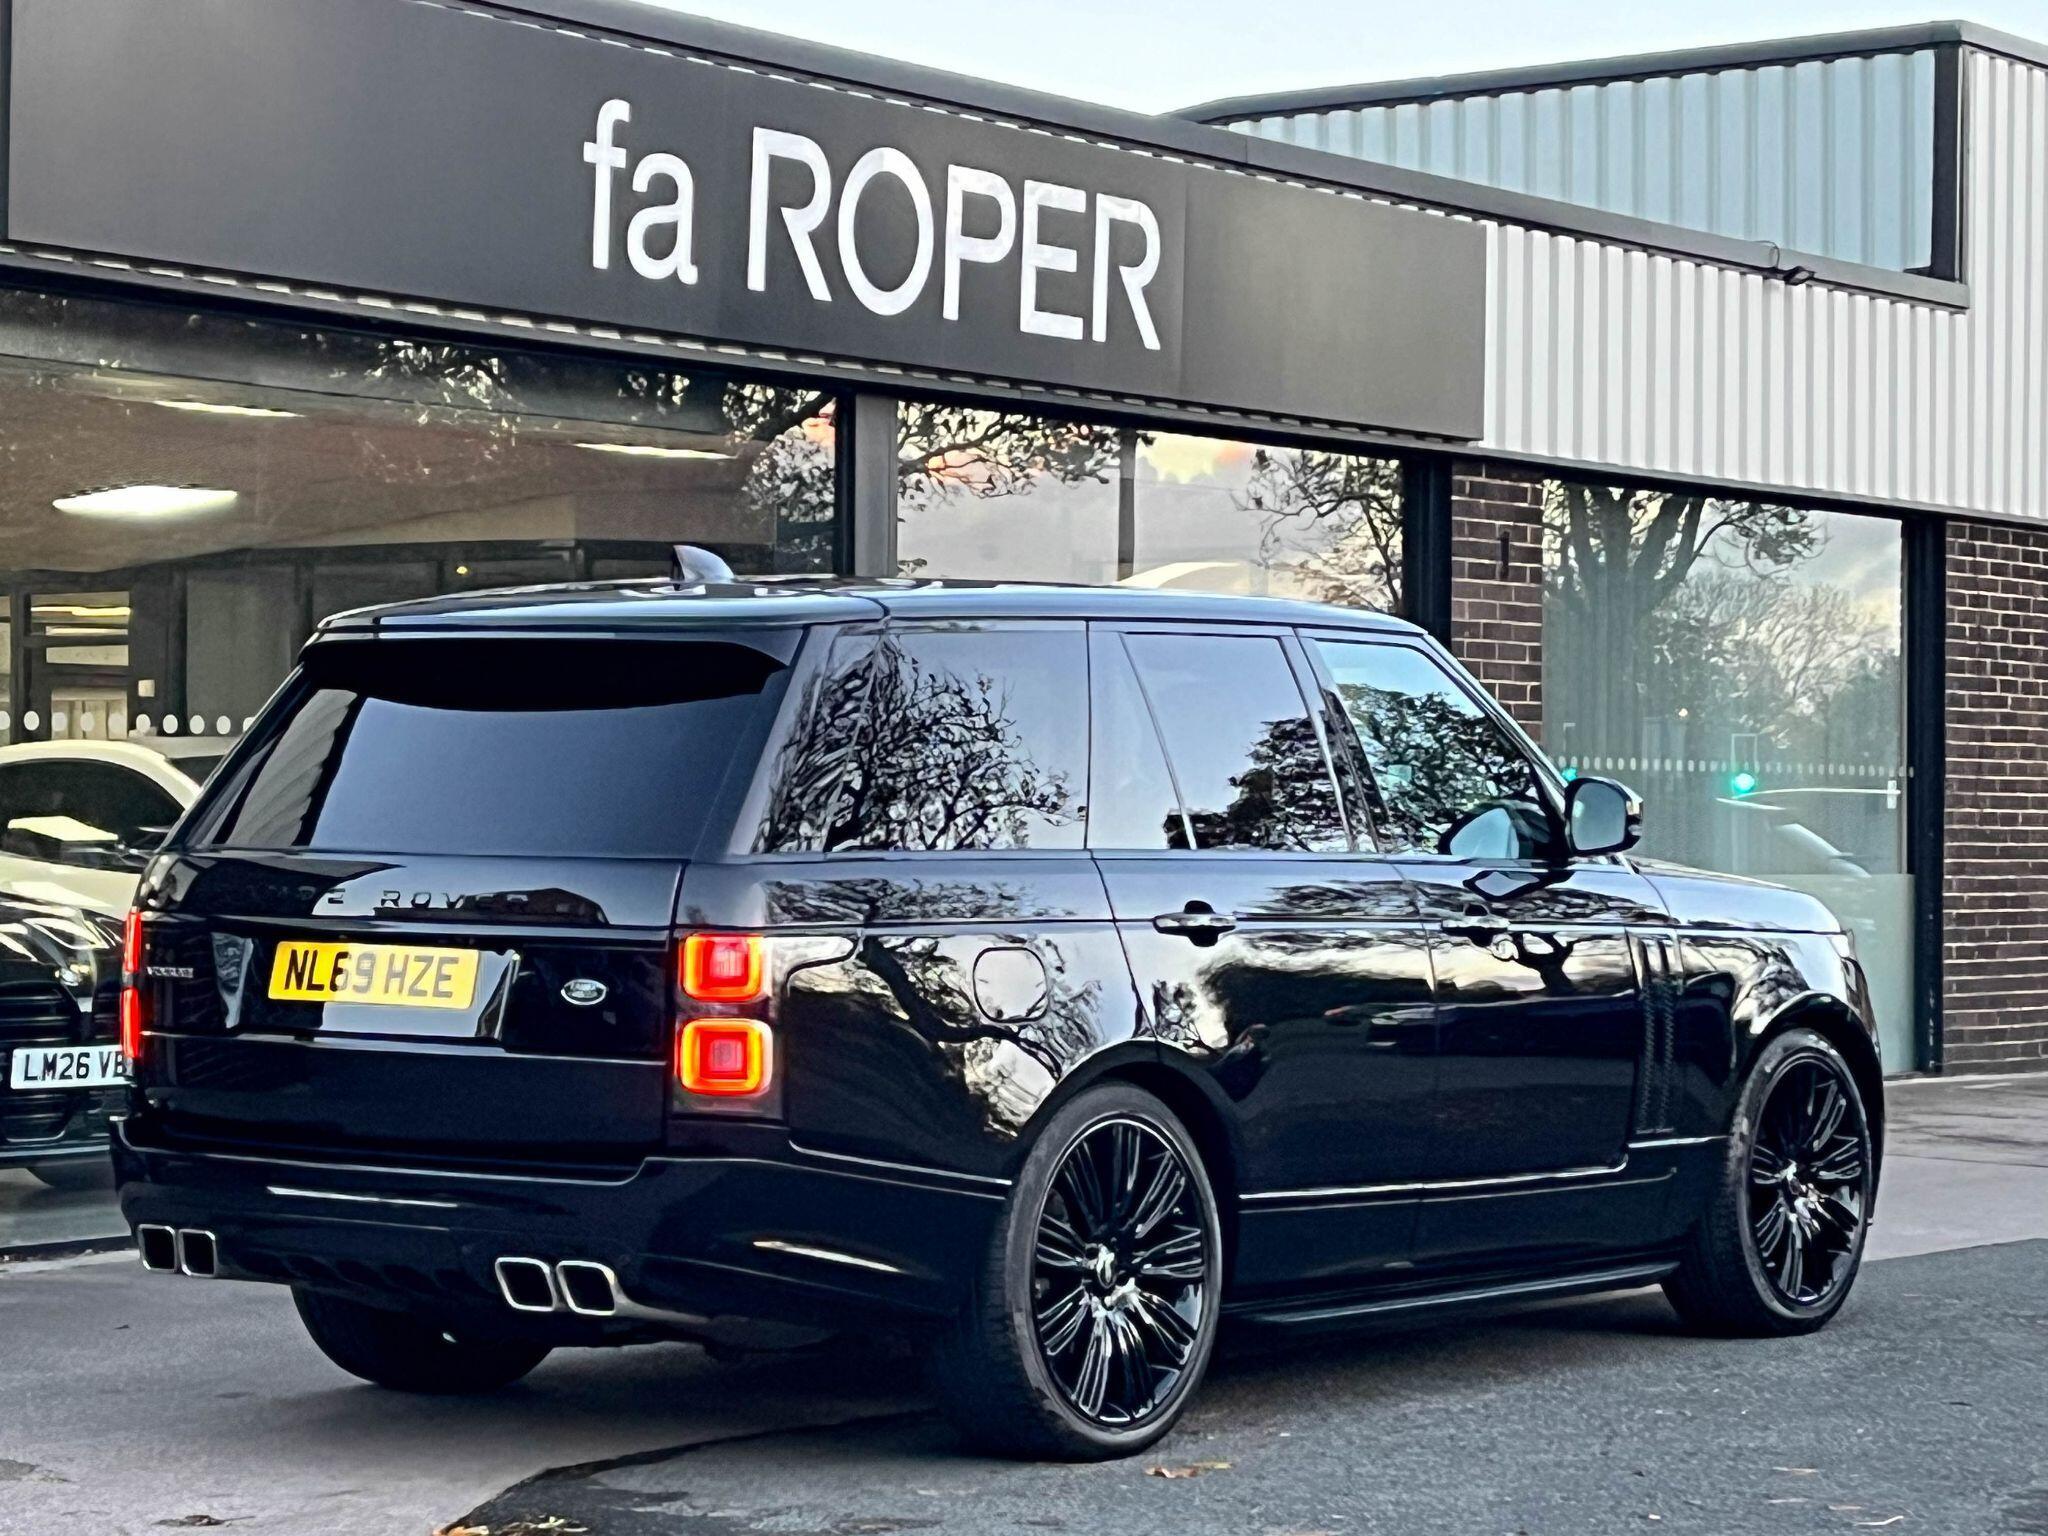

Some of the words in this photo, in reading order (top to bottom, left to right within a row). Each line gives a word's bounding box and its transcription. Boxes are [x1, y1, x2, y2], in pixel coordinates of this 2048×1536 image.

[583, 98, 698, 285] fa
[747, 126, 1161, 351] ROPER
[284, 949, 376, 994] NL69
[384, 953, 459, 998] HZE
[23, 1051, 91, 1082] LM26
